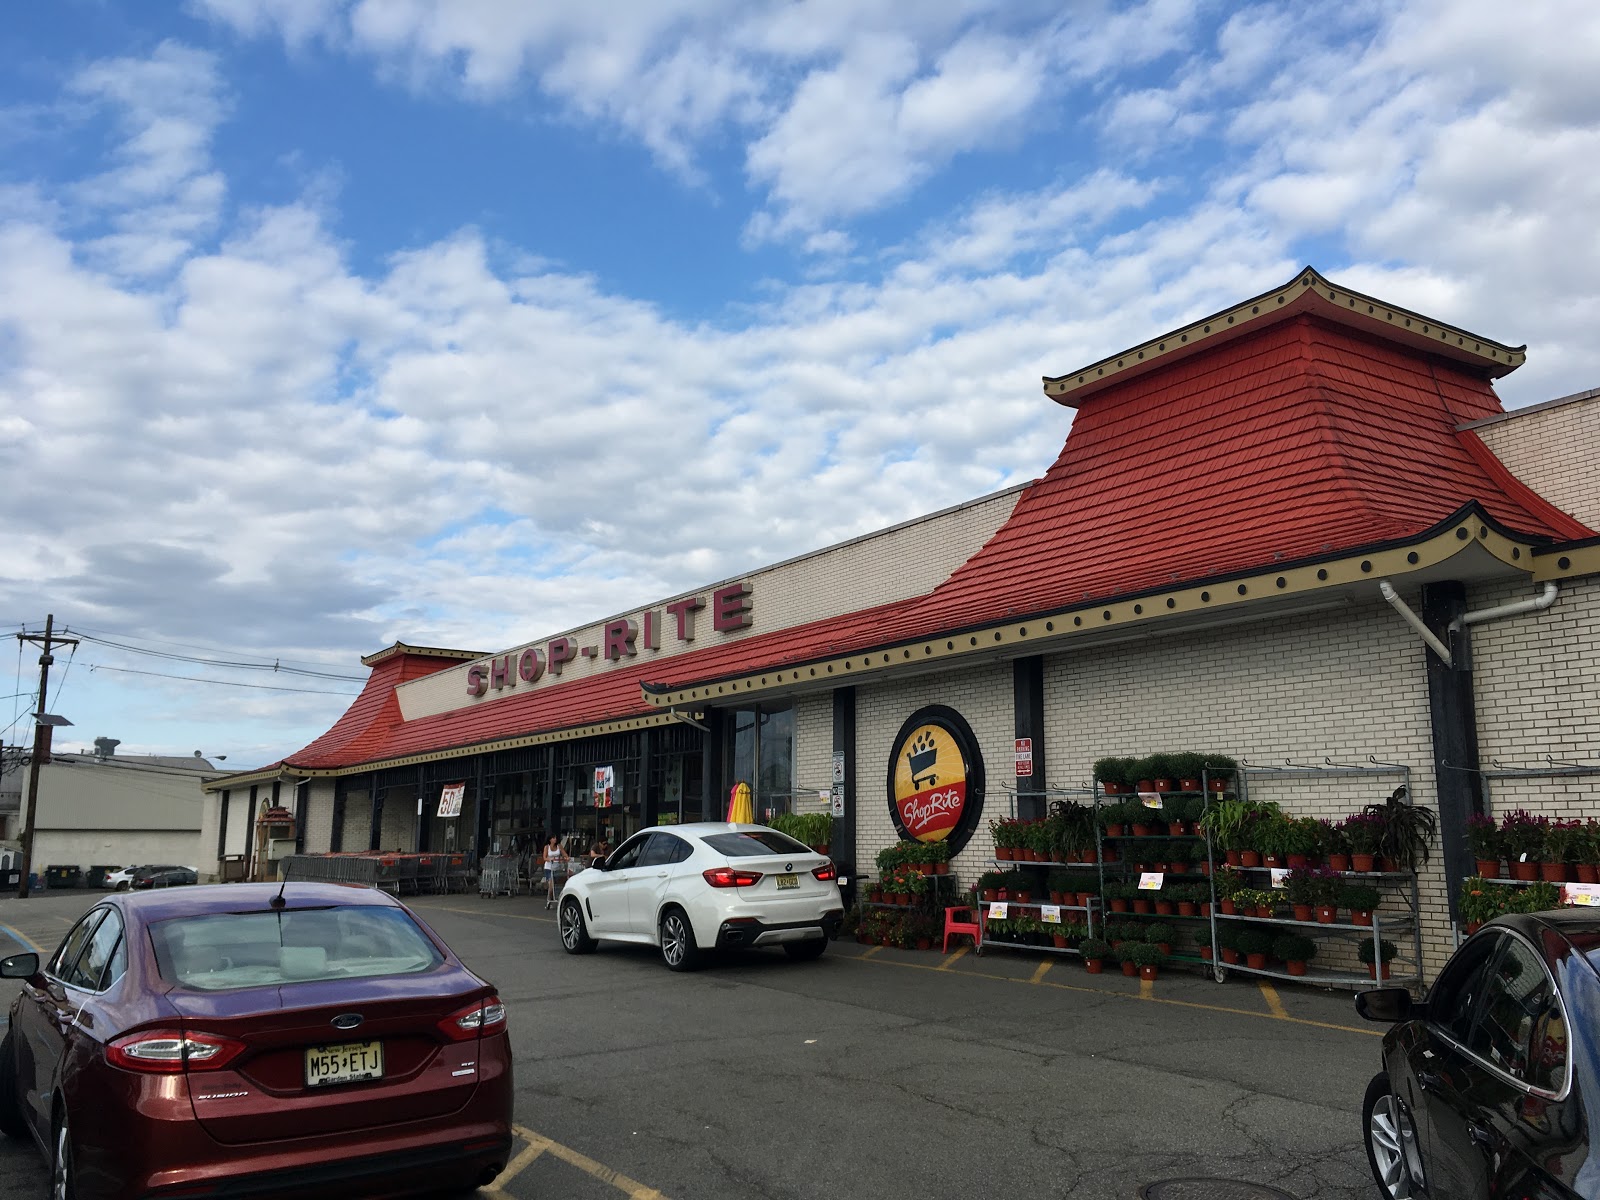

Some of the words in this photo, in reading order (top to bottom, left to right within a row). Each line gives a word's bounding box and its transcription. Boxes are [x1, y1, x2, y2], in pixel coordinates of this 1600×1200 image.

[467, 583, 753, 697] SHOP-RITE
[904, 789, 960, 828] ShopRite
[311, 1055, 340, 1077] M55
[349, 1050, 378, 1072] ETJ
[325, 1046, 340, 1054] New
[342, 1045, 362, 1053] Jersey
